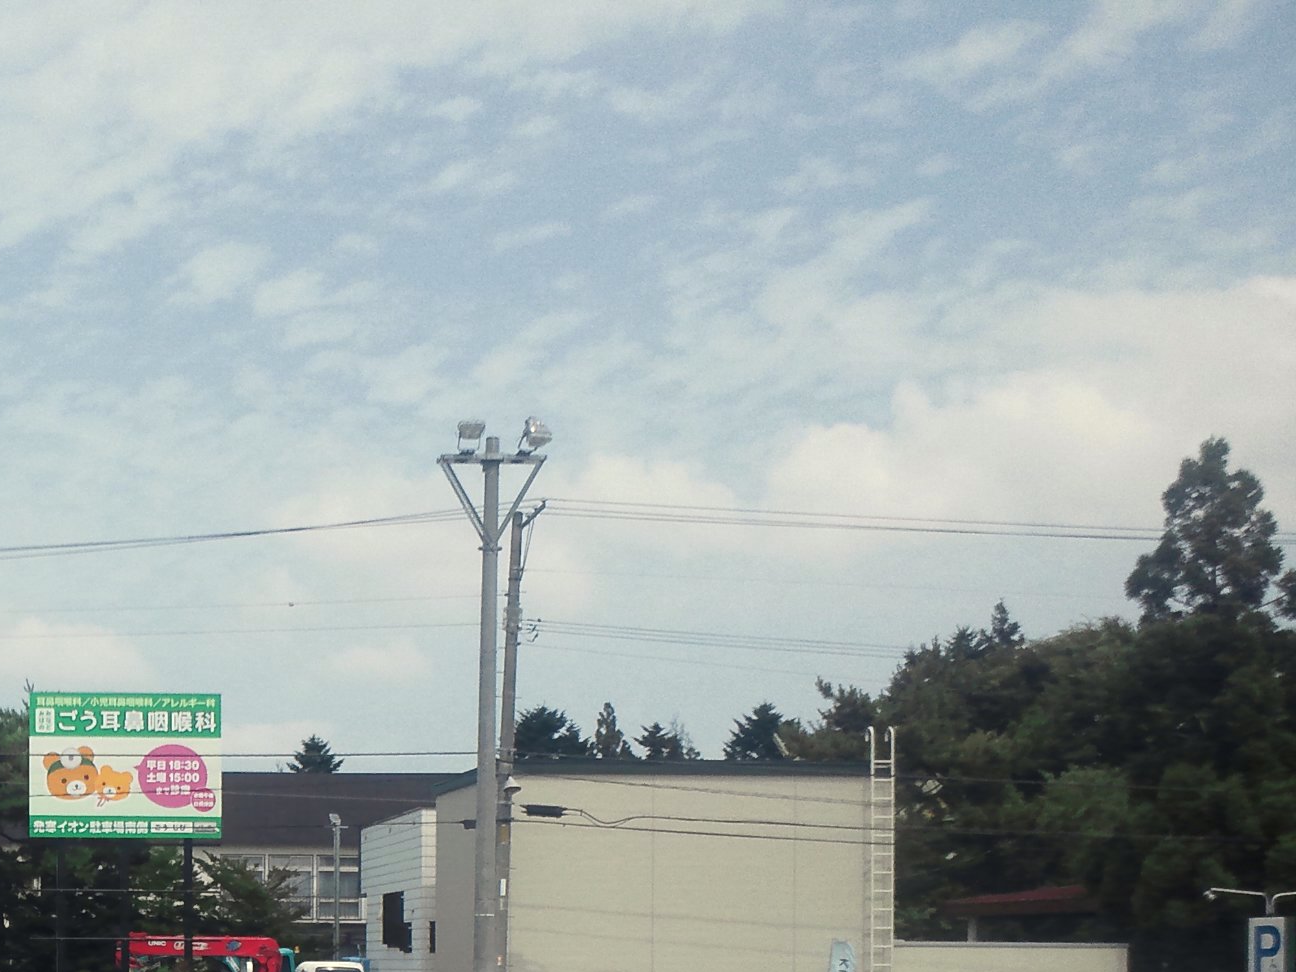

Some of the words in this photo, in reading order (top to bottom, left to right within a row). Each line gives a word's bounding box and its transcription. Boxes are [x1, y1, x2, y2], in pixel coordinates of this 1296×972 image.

[58, 709, 216, 733] ごう耳鼻咽喉科
[146, 760, 166, 771] 平日
[169, 760, 200, 771] 18:30
[146, 772, 166, 783] 土曜
[169, 772, 200, 783] 15:00
